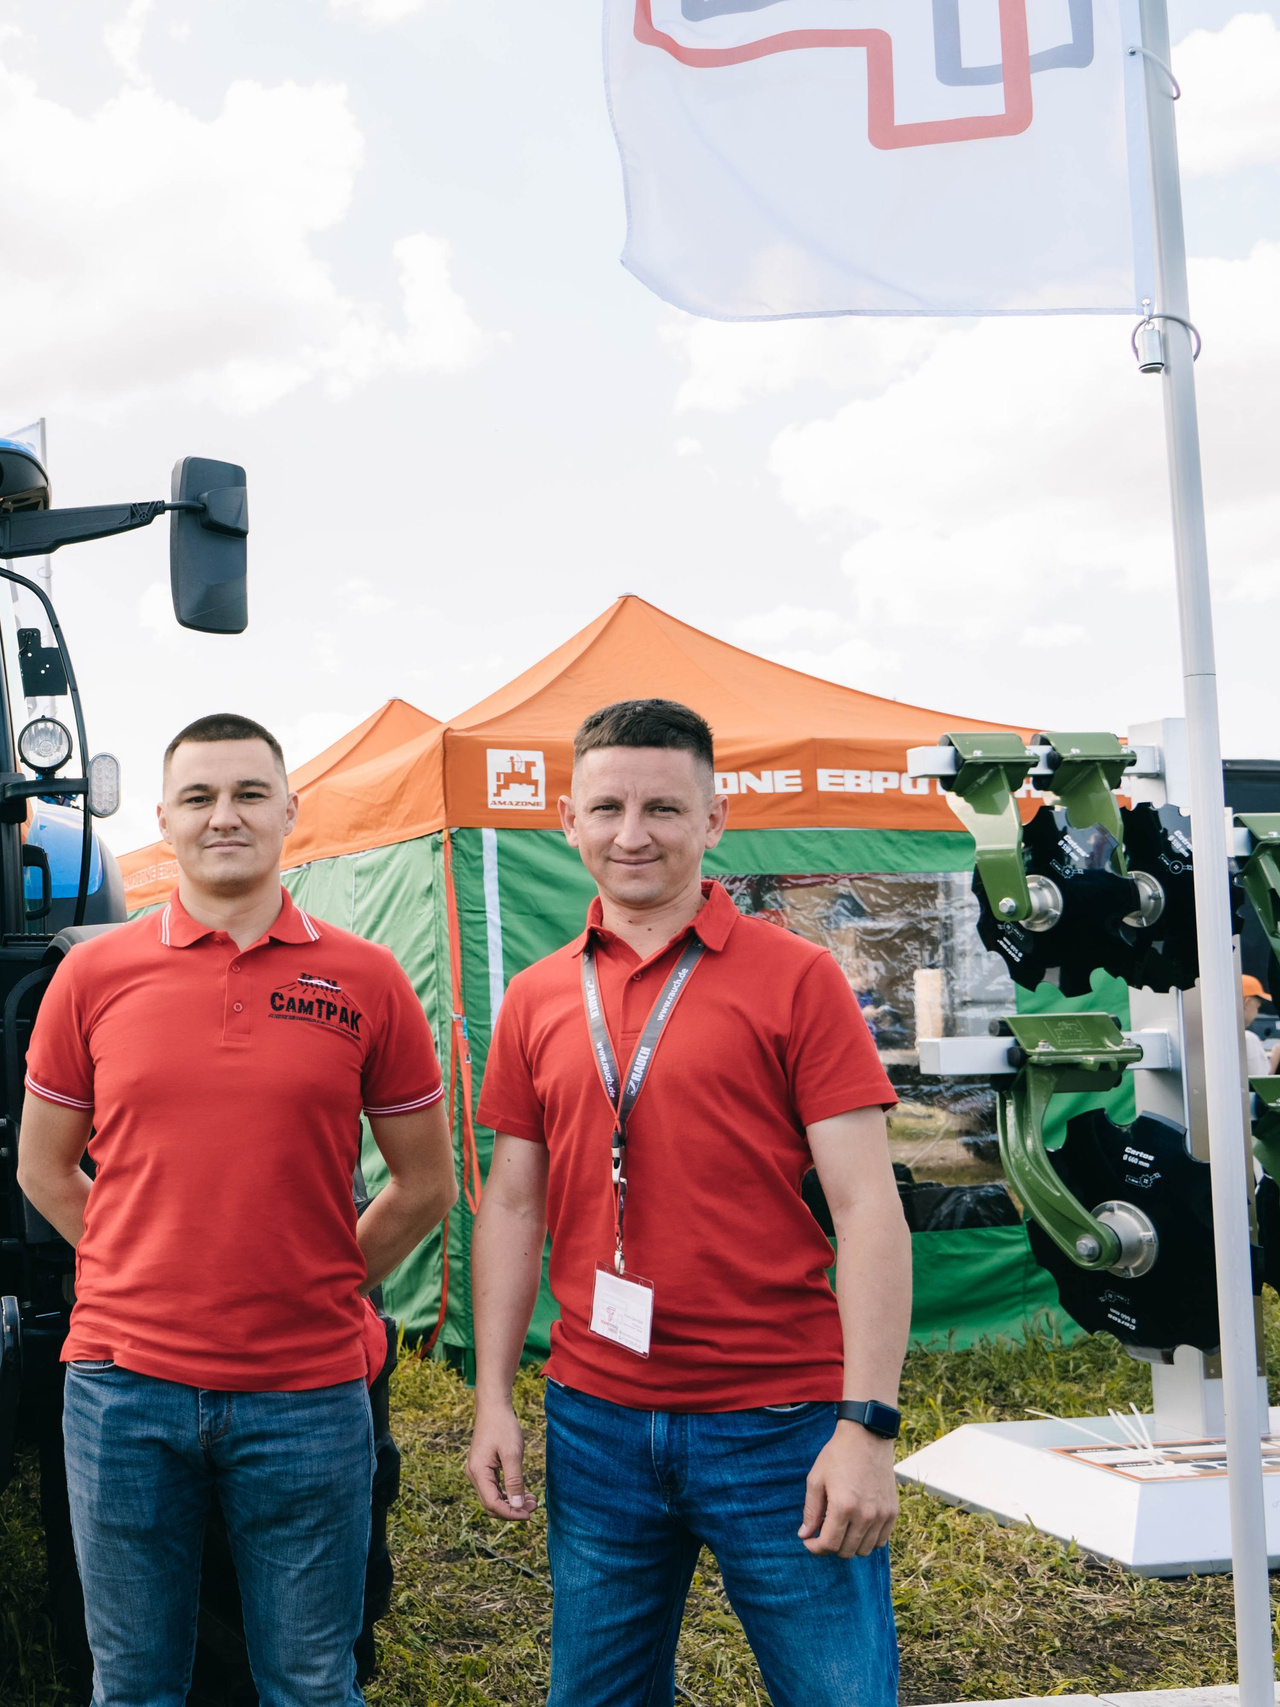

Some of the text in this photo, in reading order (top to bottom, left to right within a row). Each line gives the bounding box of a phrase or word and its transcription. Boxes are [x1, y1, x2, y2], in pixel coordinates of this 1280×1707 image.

[490, 800, 544, 808] AMAZONE
[657, 967, 689, 1022] www.rauch.de
[596, 1041, 616, 1099] www.rauch.de
[631, 1046, 652, 1082] RAUCH
[1128, 1155, 1139, 1164] 660
[1138, 1160, 1150, 1168] mm
